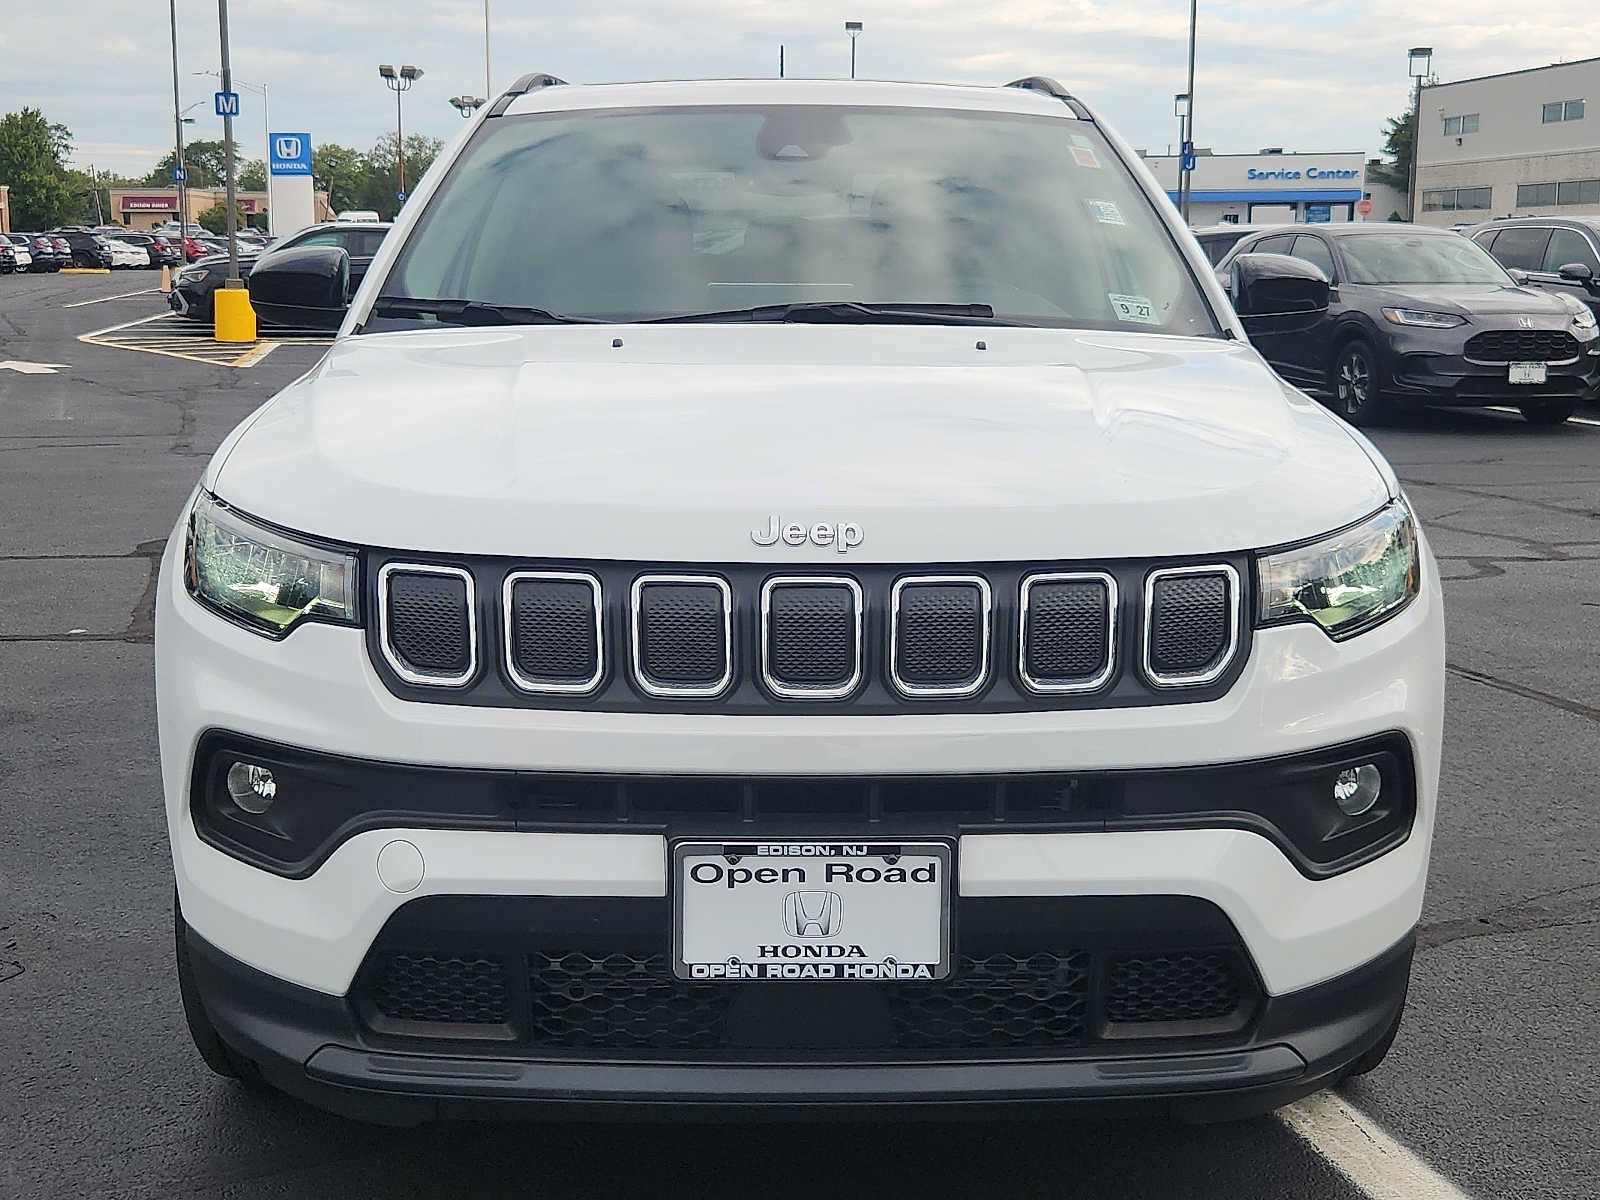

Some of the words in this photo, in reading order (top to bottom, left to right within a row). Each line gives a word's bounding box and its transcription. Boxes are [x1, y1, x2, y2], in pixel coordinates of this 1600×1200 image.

[219, 95, 237, 114] M
[272, 162, 308, 170] HONDA
[1185, 157, 1193, 169] J
[176, 170, 184, 180] N
[1247, 168, 1301, 180] Service
[1306, 167, 1359, 180] Center
[1120, 303, 1130, 314] 9
[1136, 305, 1150, 317] 27
[750, 514, 865, 553] Jeep
[757, 845, 836, 856] EDISON,
[842, 845, 868, 856] NJ
[690, 863, 806, 889] Open
[825, 862, 936, 883] Road
[757, 944, 869, 959] HONDA
[691, 964, 758, 978] OPEN
[766, 964, 836, 978] ROAD
[843, 964, 932, 978] HONDA
